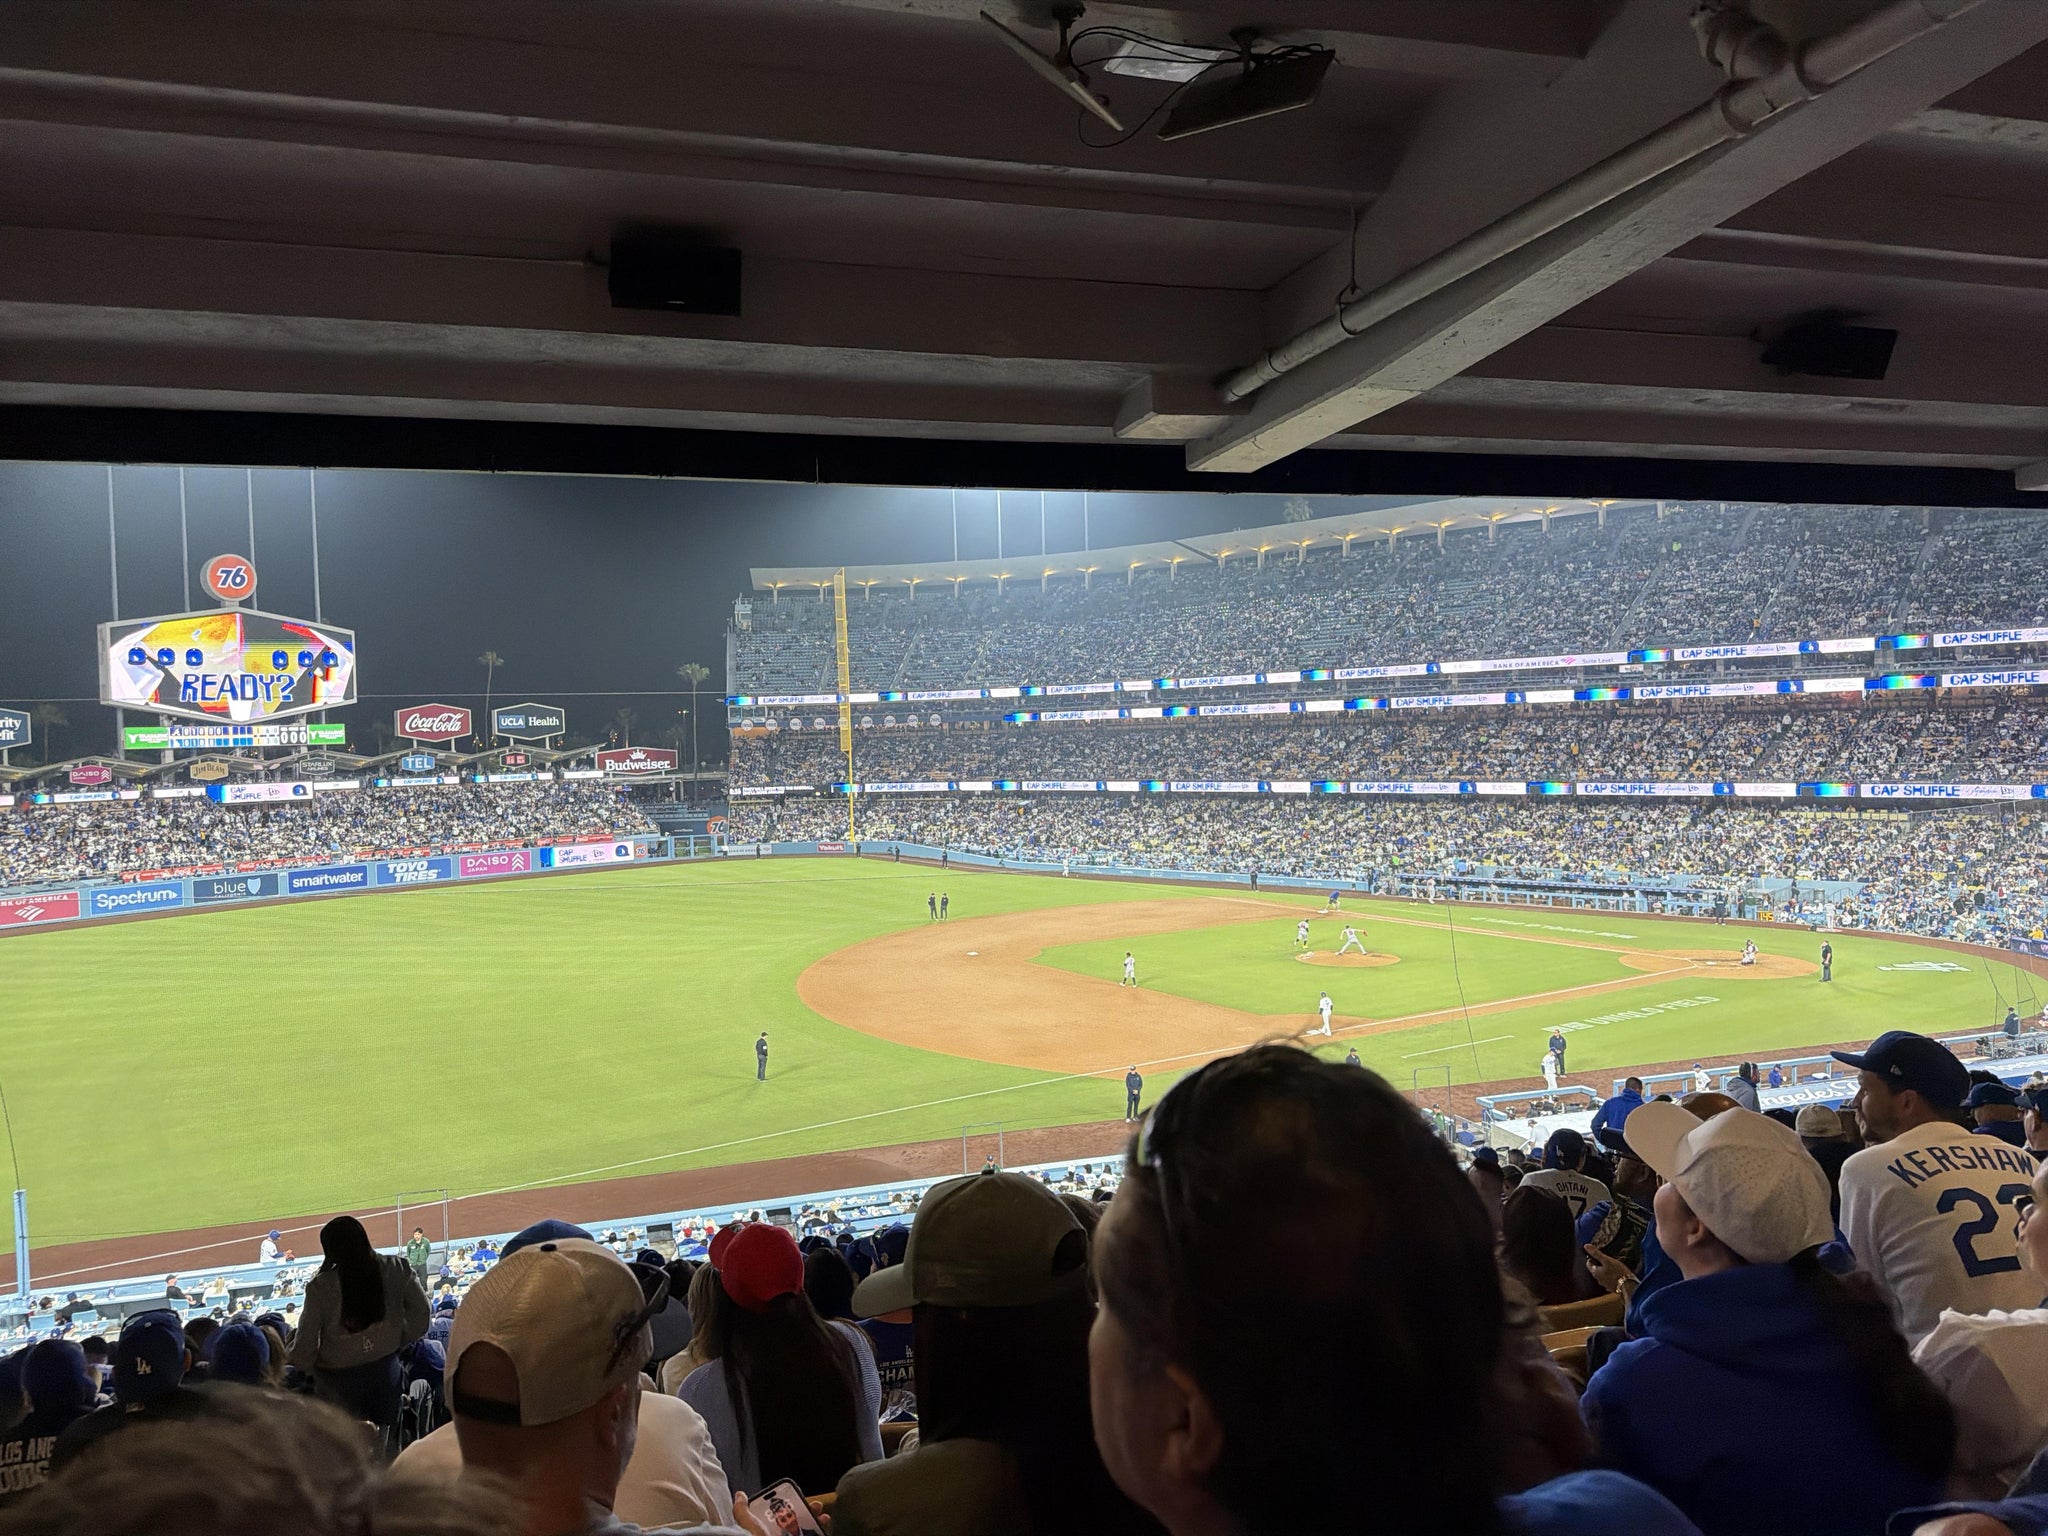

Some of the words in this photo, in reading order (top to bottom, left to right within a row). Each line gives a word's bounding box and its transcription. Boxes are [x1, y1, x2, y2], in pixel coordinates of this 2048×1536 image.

[217, 567, 247, 589] 76
[1943, 634, 1968, 644] CAP
[1972, 631, 2022, 642] SHUFFLE
[1681, 650, 1703, 658] CAP
[1705, 647, 1747, 656] SHUFFLE
[1525, 660, 1560, 668] AMERICA
[1357, 668, 1388, 676] SHUFFLE
[1951, 675, 1978, 685] CAP
[1983, 672, 2039, 683] SHUFFLE
[180, 673, 296, 703] READY?
[1640, 688, 1662, 697] CAP
[1666, 686, 1711, 696] SHUFFLE
[1396, 698, 1414, 706] CAP
[1416, 696, 1453, 705] SHUFFLE
[1220, 705, 1248, 713] SHUFFLE
[405, 712, 465, 733] Coca-Cola
[501, 717, 524, 726] UCLA
[528, 717, 560, 727] Health
[281, 731, 288, 744] 0
[290, 731, 298, 744] 0
[299, 731, 306, 744] 0
[406, 758, 432, 769] TEL
[605, 759, 671, 771] Budweiser
[194, 764, 206, 776] JIM
[1357, 784, 1374, 792] CAP
[1377, 783, 1413, 792] SHUFFLE
[1584, 784, 1607, 793] CAP
[1610, 784, 1656, 794] SHUFFLE
[1871, 786, 1899, 796] CAP
[1904, 785, 1960, 796] SHUFFLE
[710, 820, 727, 833] 76
[559, 849, 573, 857] CAP
[635, 847, 645, 855] 76
[467, 856, 508, 867] DAISO
[559, 855, 587, 864] SHUFFLE
[388, 861, 428, 873] TOYO
[292, 872, 363, 888] smartwater
[394, 870, 438, 883] TIRES
[214, 881, 246, 895] blue
[28, 895, 69, 905] AMERICA
[97, 889, 174, 909] Spectrum
[1656, 996, 1721, 1010] FIELD
[1887, 1146, 2035, 1189] KERSHAW
[1556, 1181, 1589, 1196] OHTANI
[136, 1357, 152, 1375] LA
